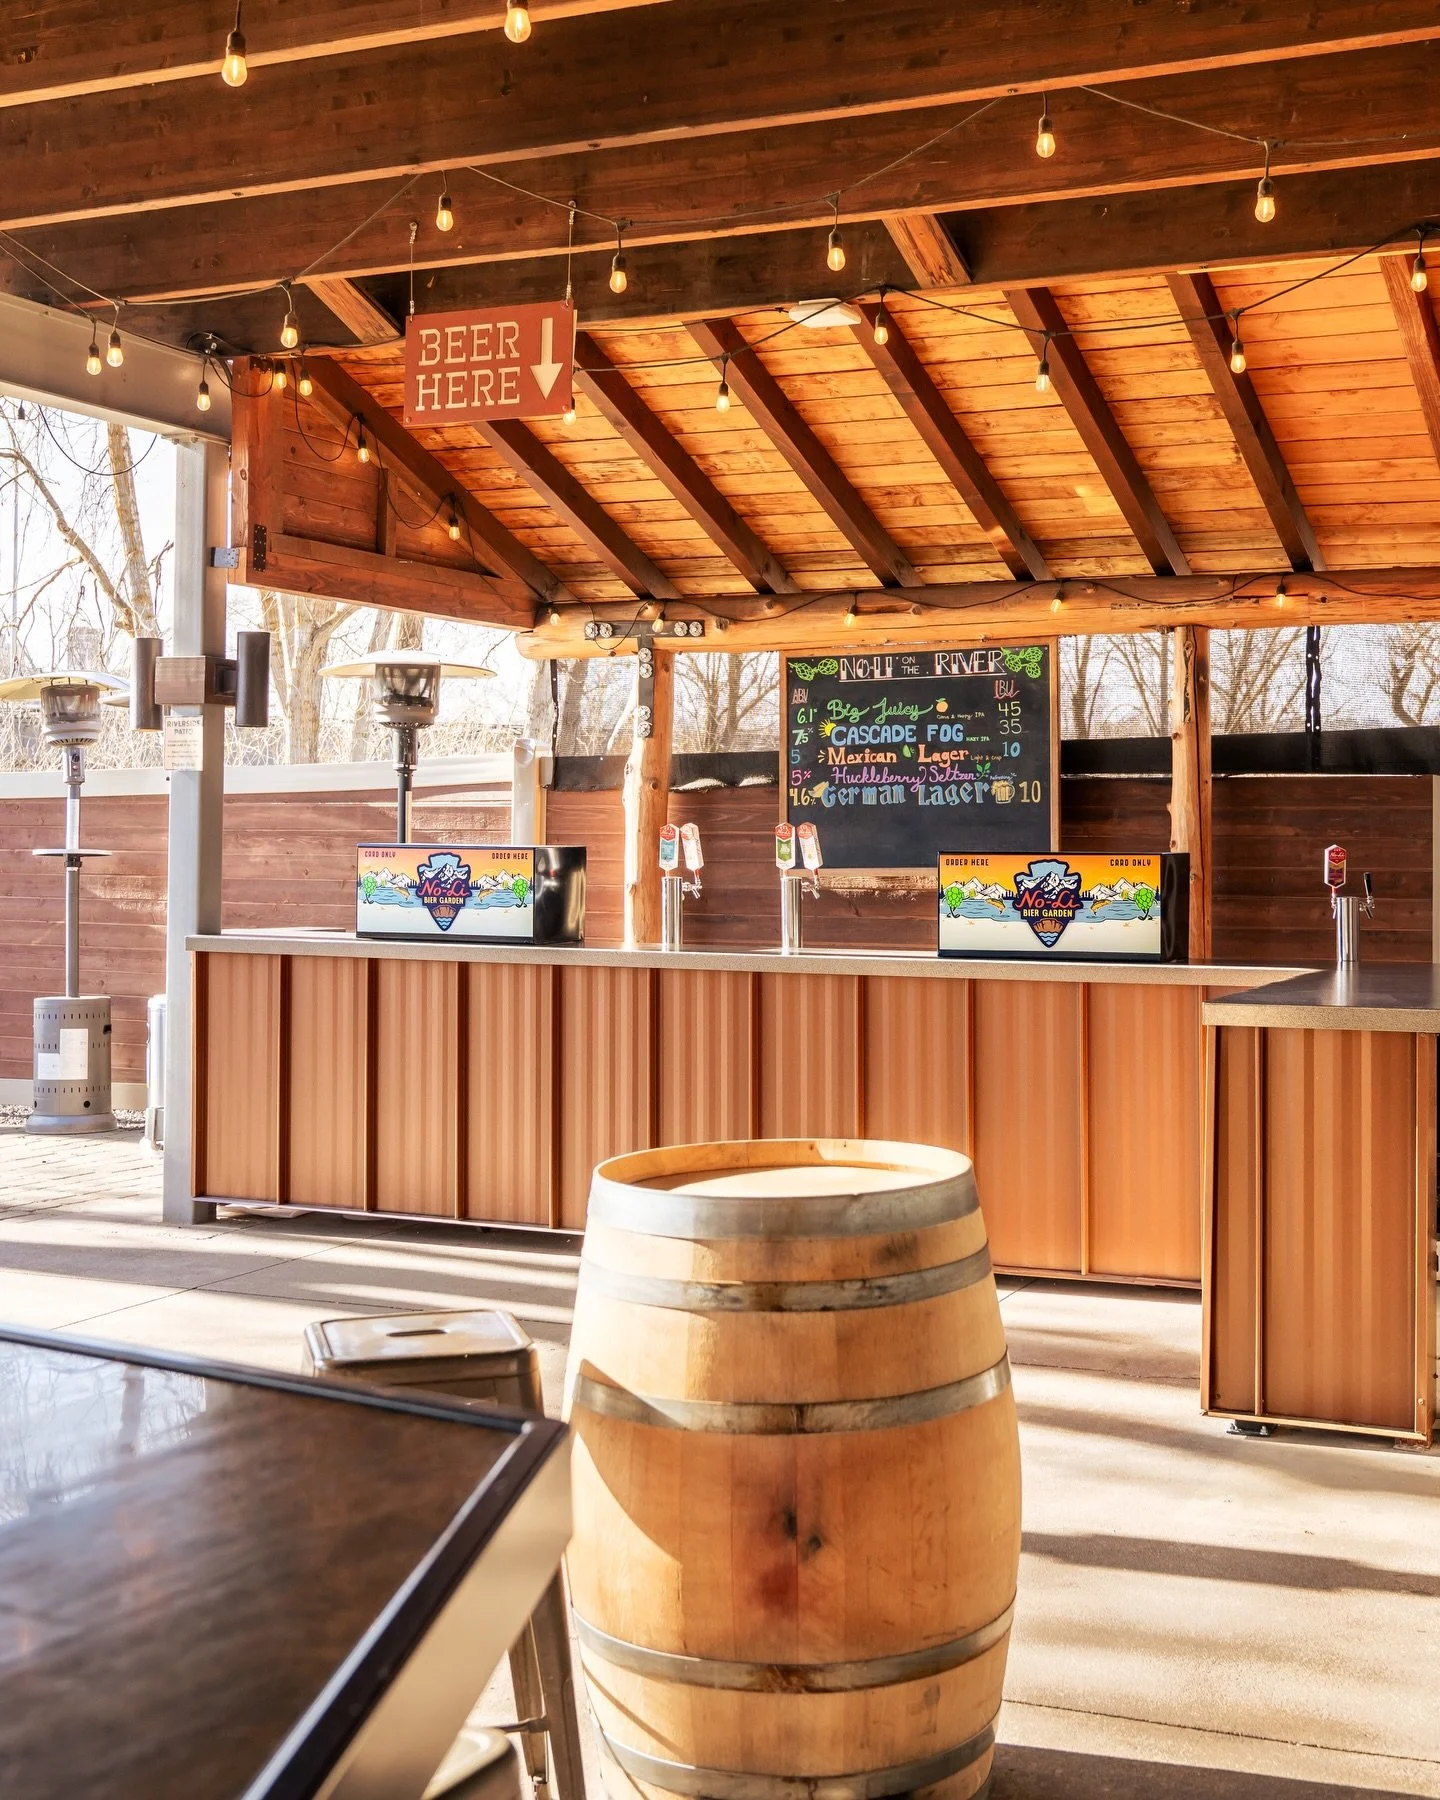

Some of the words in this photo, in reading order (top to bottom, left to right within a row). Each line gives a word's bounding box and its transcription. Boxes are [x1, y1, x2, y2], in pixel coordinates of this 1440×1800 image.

[418, 321, 520, 366] BEER
[415, 366, 521, 411] HERE
[901, 656, 916, 664] ON
[934, 650, 1005, 675] RIVER
[901, 665, 920, 675] THE
[791, 688, 809, 704] ABV
[827, 698, 870, 724] Big
[872, 697, 934, 724] Juicy
[998, 701, 1021, 717] 45
[831, 724, 917, 746] CASCADE
[927, 723, 964, 743] FOG
[999, 719, 1022, 735] 35
[827, 747, 897, 765] Mexican
[917, 744, 969, 768] Lager
[1002, 741, 1020, 758] 10
[831, 765, 927, 793] Huckleberry
[821, 784, 907, 807] German
[918, 781, 990, 806] Lager
[1019, 780, 1041, 803] 10
[491, 852, 511, 860] ORDER
[945, 858, 970, 866] ORDER
[971, 858, 989, 866] HERE
[1110, 858, 1129, 867] CARD
[1132, 859, 1152, 867] ONLY
[417, 879, 469, 897] No-Li
[423, 896, 437, 904] BIER
[439, 896, 464, 904] GARDEN
[1015, 890, 1081, 909] No-Li
[1022, 908, 1040, 918] BIER
[1042, 908, 1073, 918] GARDEN
